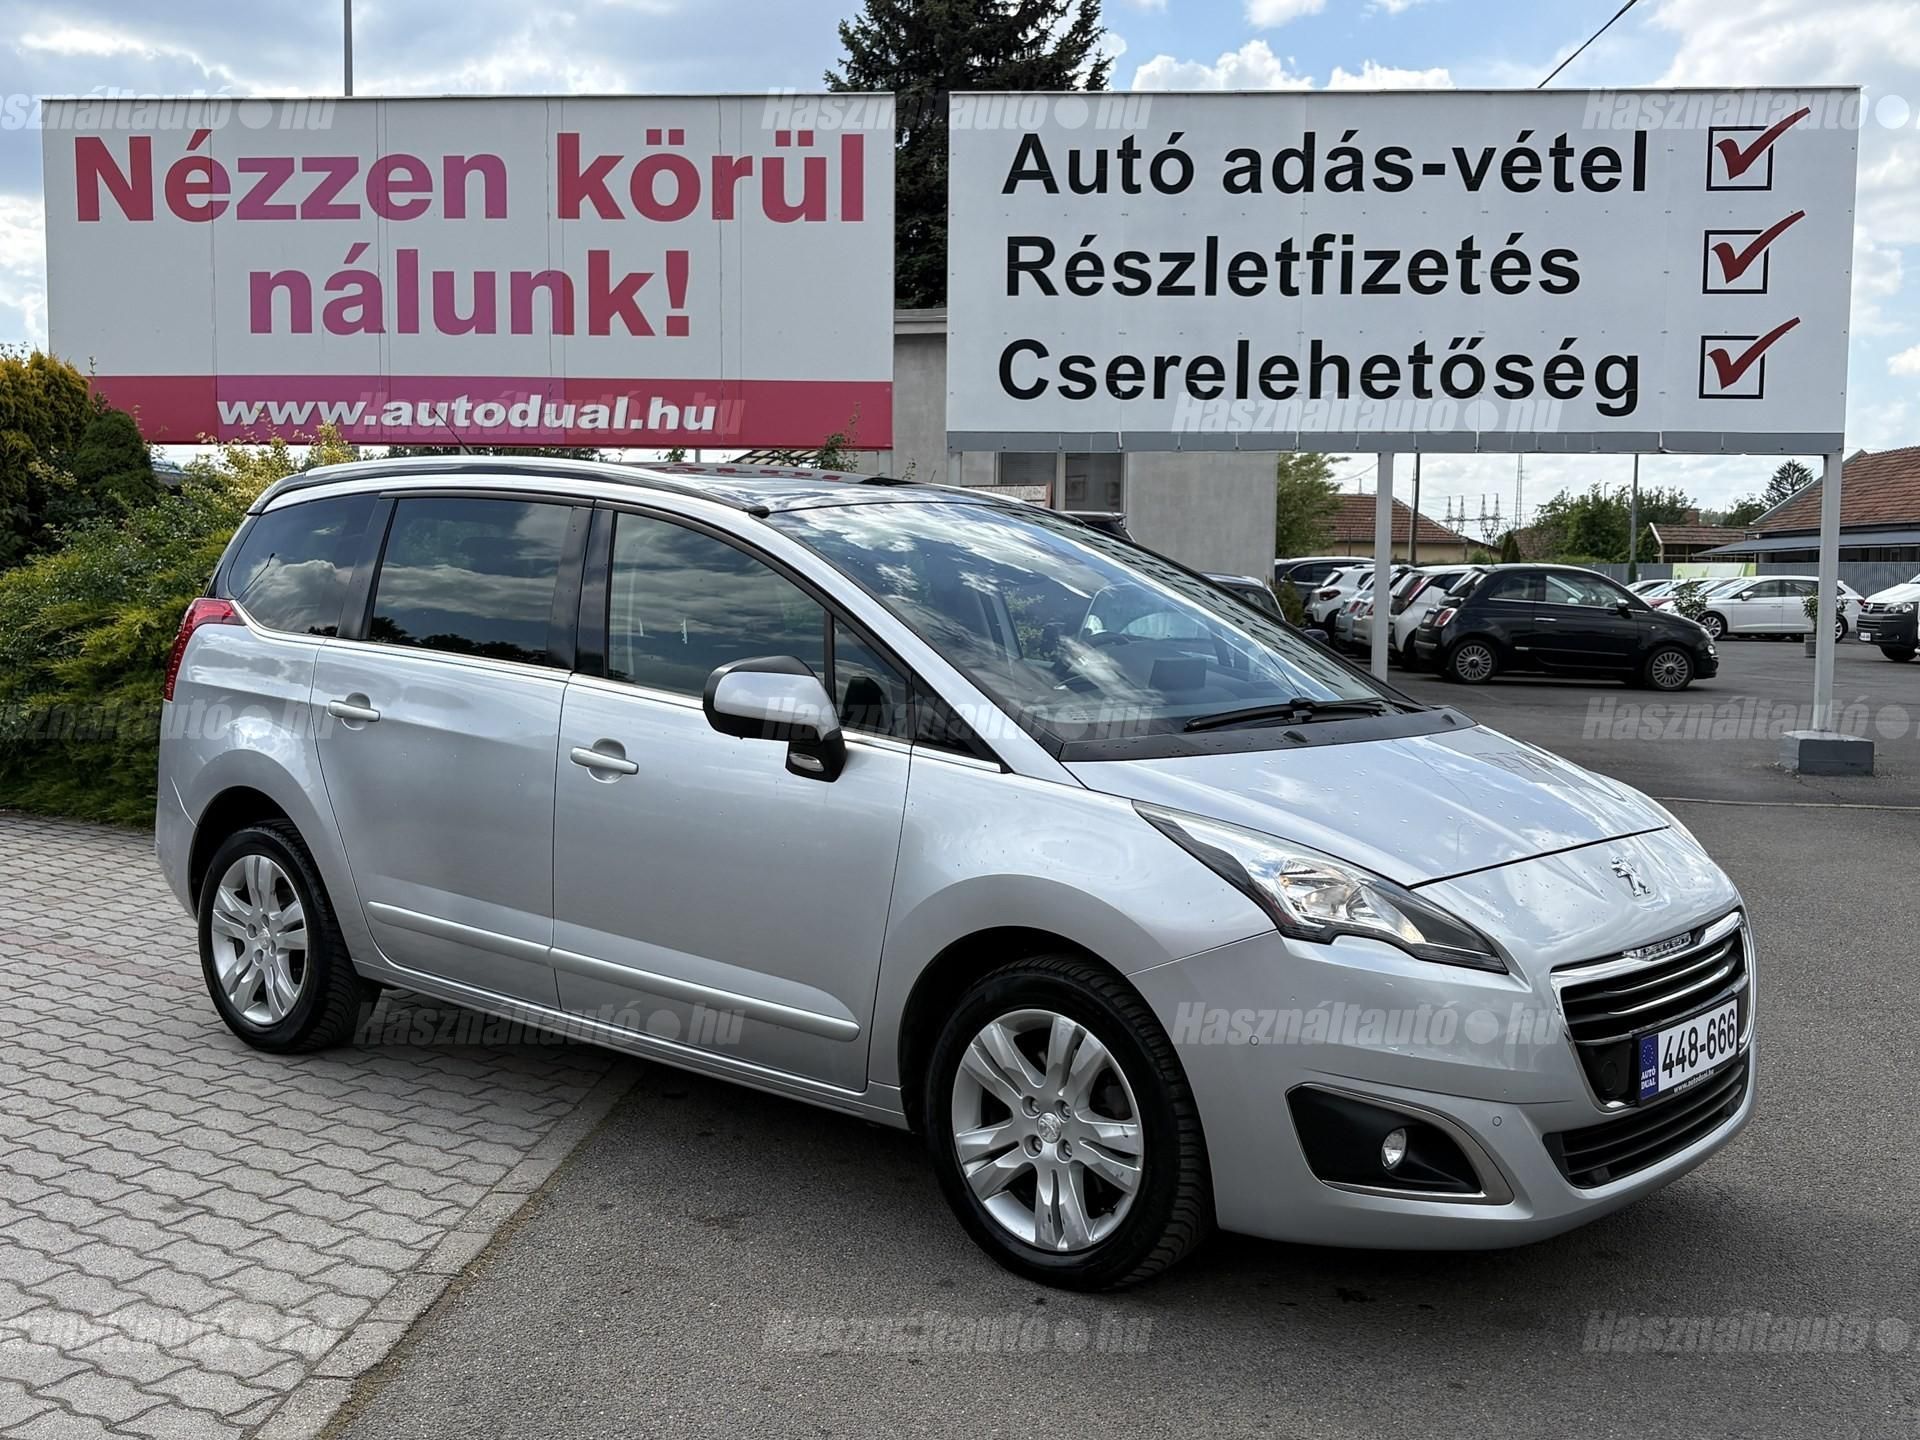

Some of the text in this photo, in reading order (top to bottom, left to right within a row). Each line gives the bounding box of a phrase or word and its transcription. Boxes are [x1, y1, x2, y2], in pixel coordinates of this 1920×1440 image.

[76, 129, 864, 223] Nézzen körül
[1001, 129, 1647, 195] Autó adás-vétel
[250, 243, 689, 337] nálunk!
[1005, 232, 1580, 297] Részletfizetés
[998, 336, 1639, 417] Cserelehetőség
[217, 394, 716, 432] www.autodual.hu
[1661, 1007, 1736, 1079] 448-666
